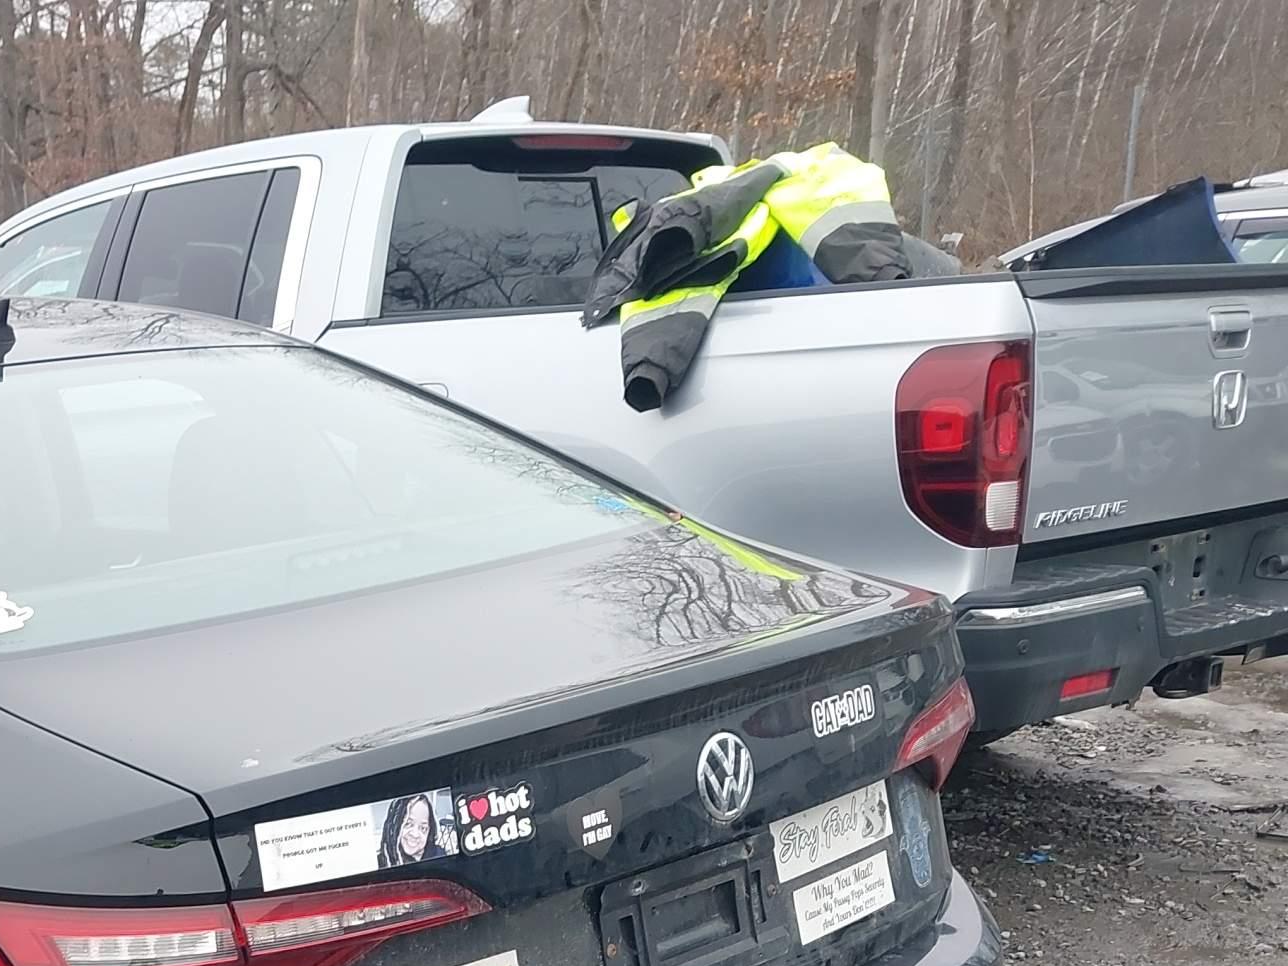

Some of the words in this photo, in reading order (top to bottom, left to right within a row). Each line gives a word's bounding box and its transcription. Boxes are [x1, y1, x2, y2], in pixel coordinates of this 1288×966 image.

[1032, 500, 1129, 529] RIDGELINE
[812, 696, 841, 737] CAT
[844, 685, 876, 726] DAD
[487, 785, 531, 817] hot
[271, 836, 283, 844] YOU
[284, 832, 302, 842] KNOW
[324, 826, 336, 834] OUT
[464, 815, 532, 851] dads
[596, 824, 612, 842] GAY
[779, 821, 820, 864] Stay
[305, 847, 318, 855] GOT
[811, 880, 835, 900] Why
[834, 875, 851, 892] You
[852, 861, 874, 881] Mad?
